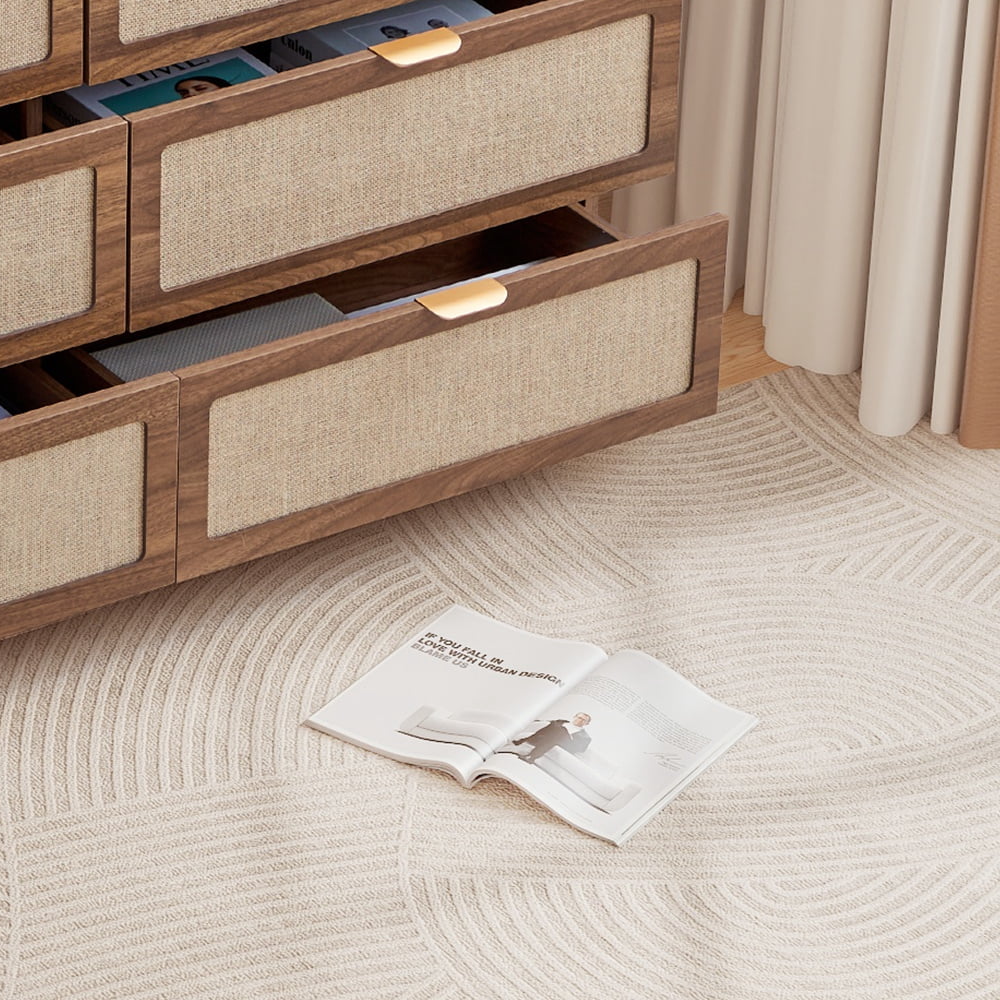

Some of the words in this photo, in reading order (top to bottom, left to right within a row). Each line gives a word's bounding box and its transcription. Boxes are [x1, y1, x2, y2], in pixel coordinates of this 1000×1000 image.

[410, 642, 452, 663] BLAME
[451, 659, 469, 669] US
[417, 637, 448, 653] LOVE
[448, 649, 478, 665] WITH
[478, 660, 518, 676] URBAN
[518, 671, 565, 688] DESIGN
[439, 636, 462, 649] YOU
[461, 646, 488, 660] FALL
[489, 657, 504, 665] IN
